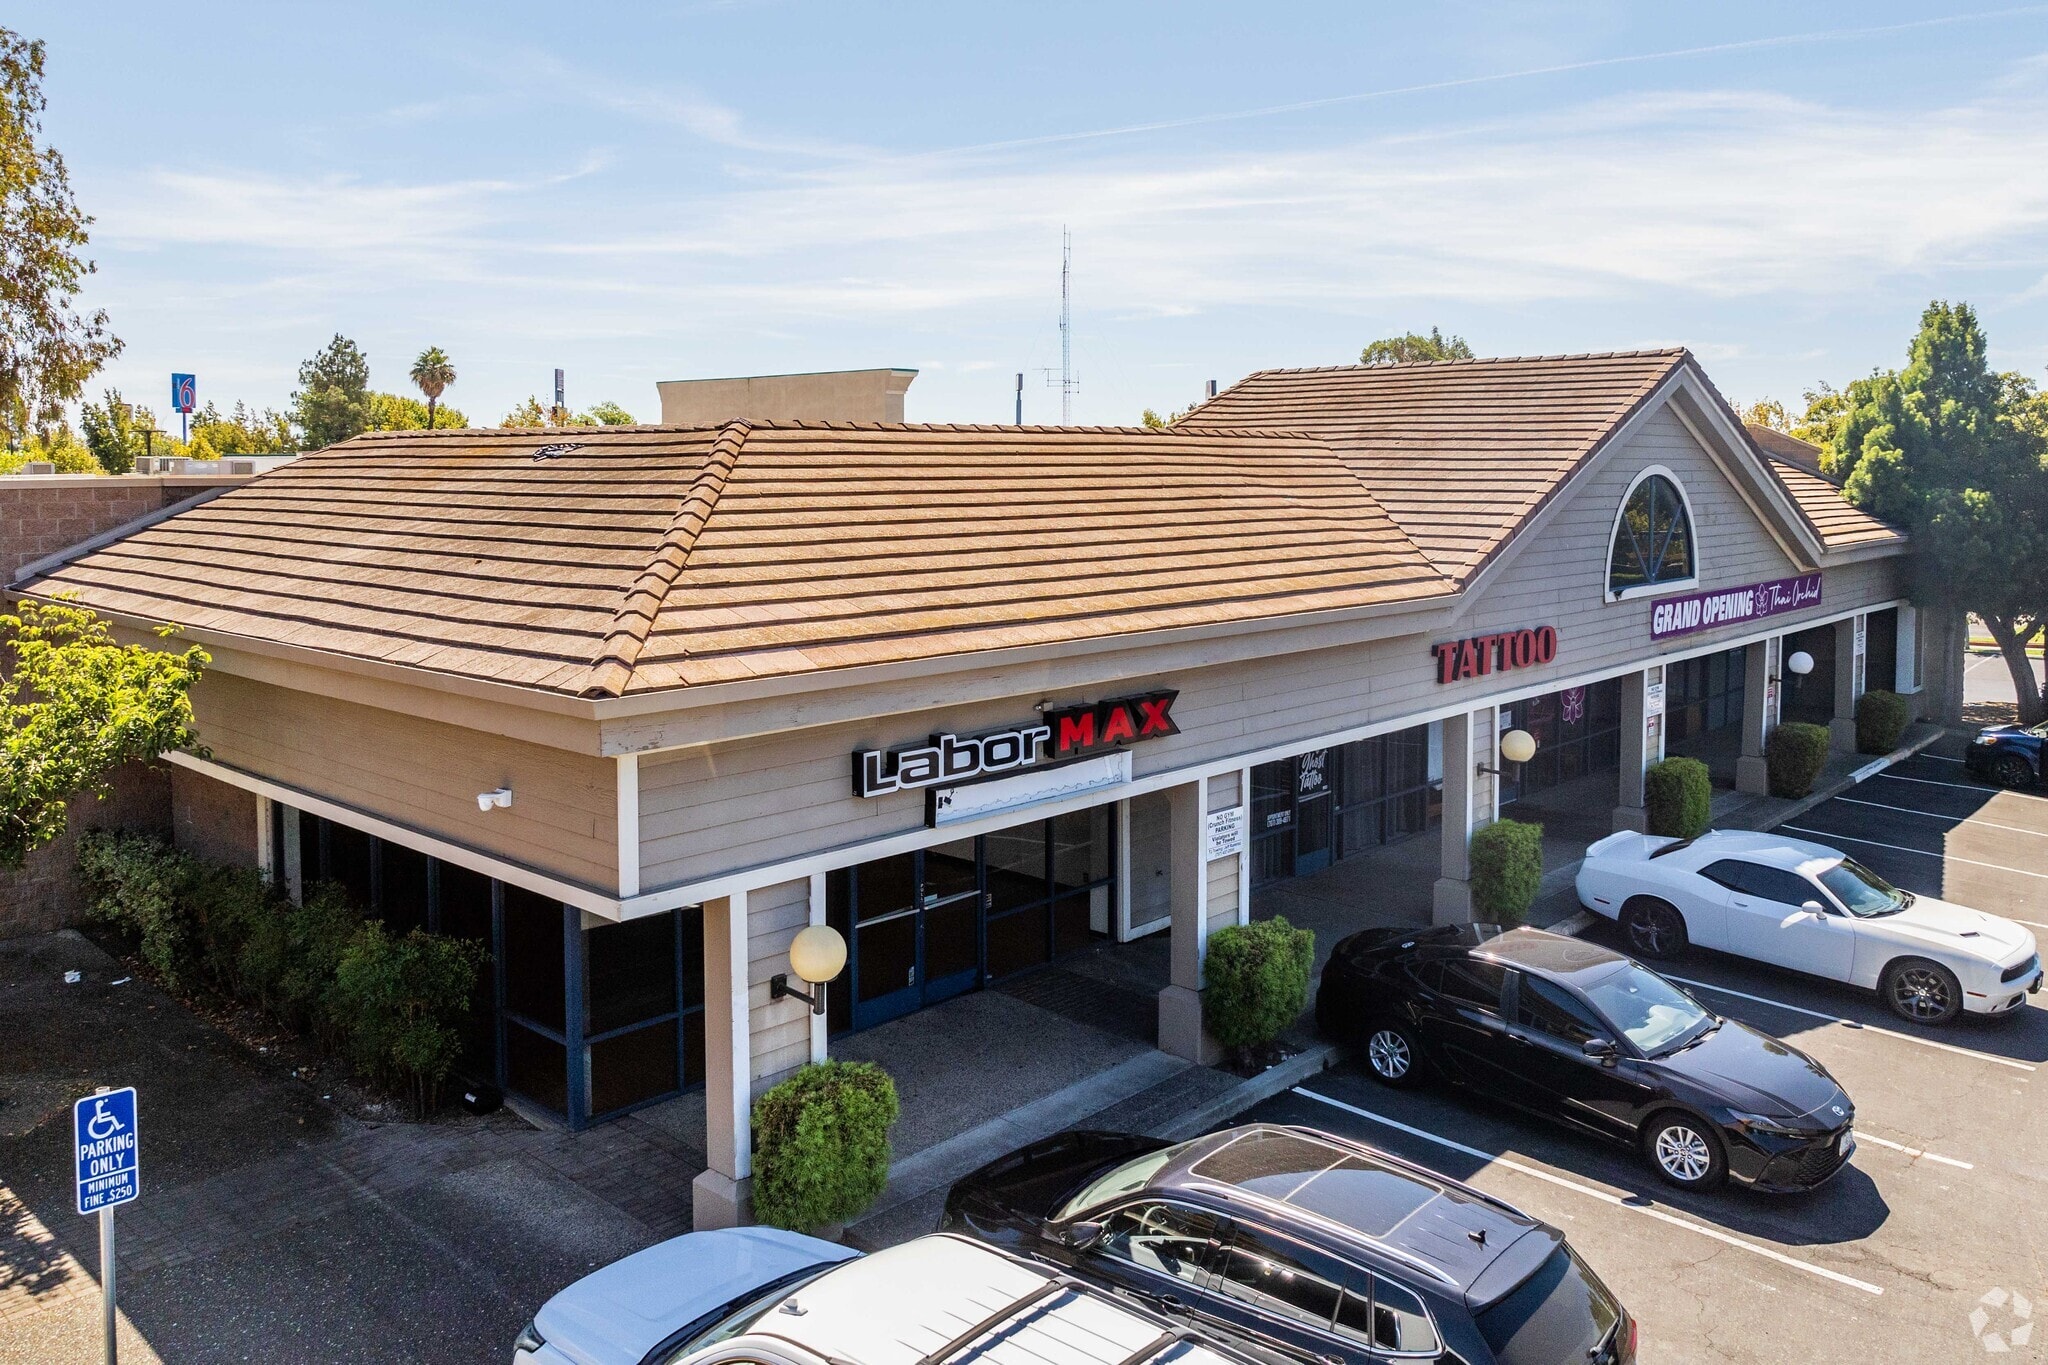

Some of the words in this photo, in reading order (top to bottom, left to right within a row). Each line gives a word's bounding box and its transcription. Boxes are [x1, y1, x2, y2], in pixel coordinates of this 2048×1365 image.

[180, 377, 195, 408] 6
[1769, 583, 1792, 610] Thai
[1792, 577, 1822, 607] Orchid
[1653, 600, 1701, 634] GRAND
[1702, 589, 1754, 625] OPENING
[1433, 625, 1557, 684] TATTOO
[1300, 769, 1322, 792] Tattoo
[1224, 811, 1235, 819] GYM
[1215, 823, 1236, 833] PARKING
[1222, 836, 1236, 844] Towed
[80, 1133, 134, 1161] PARKING
[90, 1152, 125, 1176] ONLY
[88, 1172, 128, 1194] MINIMUM
[84, 1193, 105, 1209] FINE
